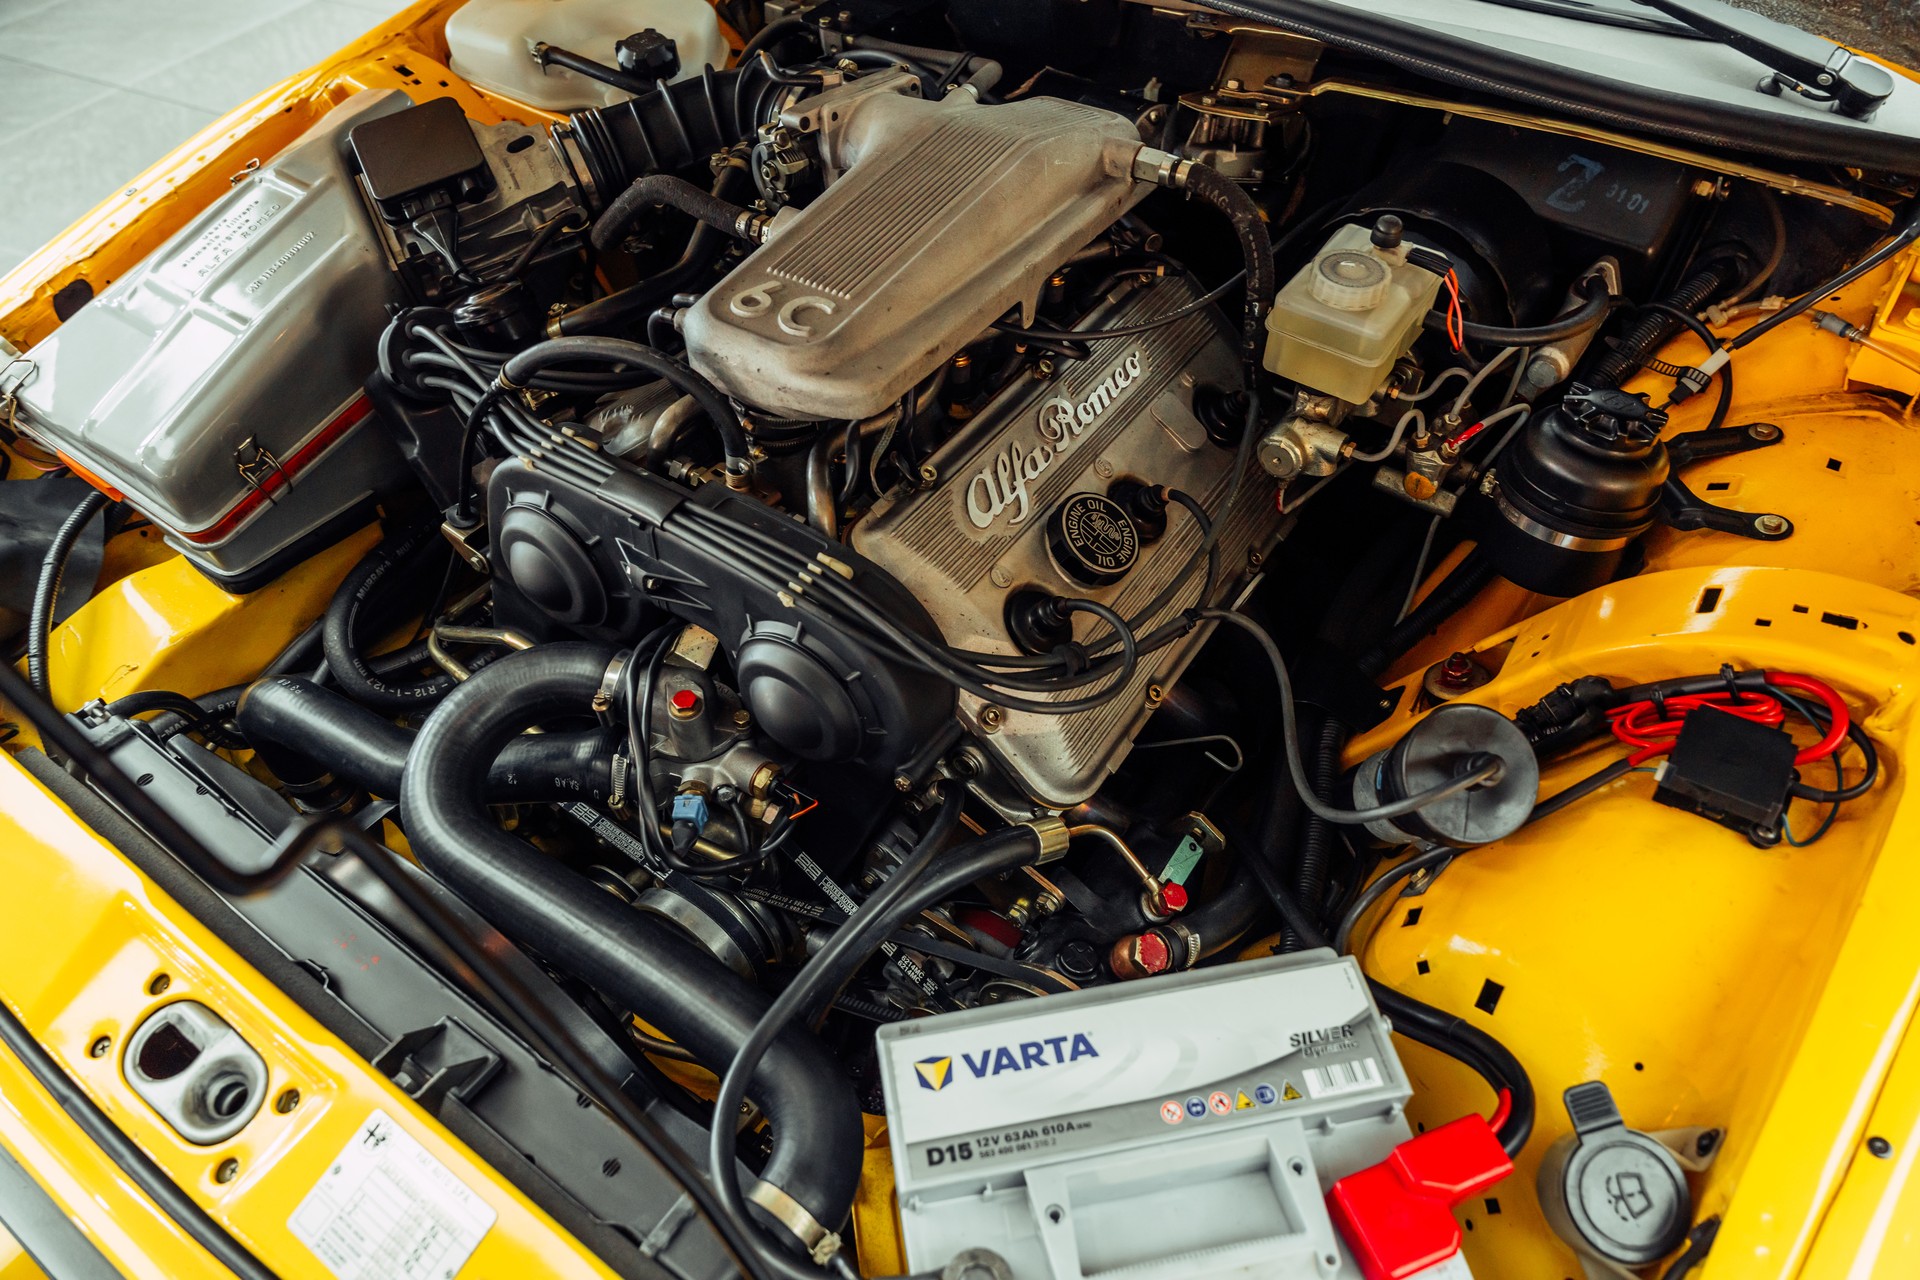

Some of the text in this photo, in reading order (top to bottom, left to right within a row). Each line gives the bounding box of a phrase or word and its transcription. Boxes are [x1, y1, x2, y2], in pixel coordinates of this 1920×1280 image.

[197, 203, 282, 278] ALFA ROMEO
[730, 280, 837, 337] 6C
[967, 350, 1140, 528] Alfa Romeo
[1068, 499, 1107, 547] ENGINE OIL
[1095, 519, 1133, 567] ENGINE OIL
[352, 657, 370, 678] mm
[821, 885, 838, 901] GATES
[835, 898, 850, 913] AUTO
[825, 880, 854, 908] GATES AUTO
[896, 959, 921, 984] 6214MC
[900, 954, 925, 979] 6214MC
[1289, 1023, 1354, 1048] SILVER
[961, 1032, 1099, 1079] VARTA
[976, 1133, 1000, 1147] 12V
[925, 1142, 974, 1167] D15
